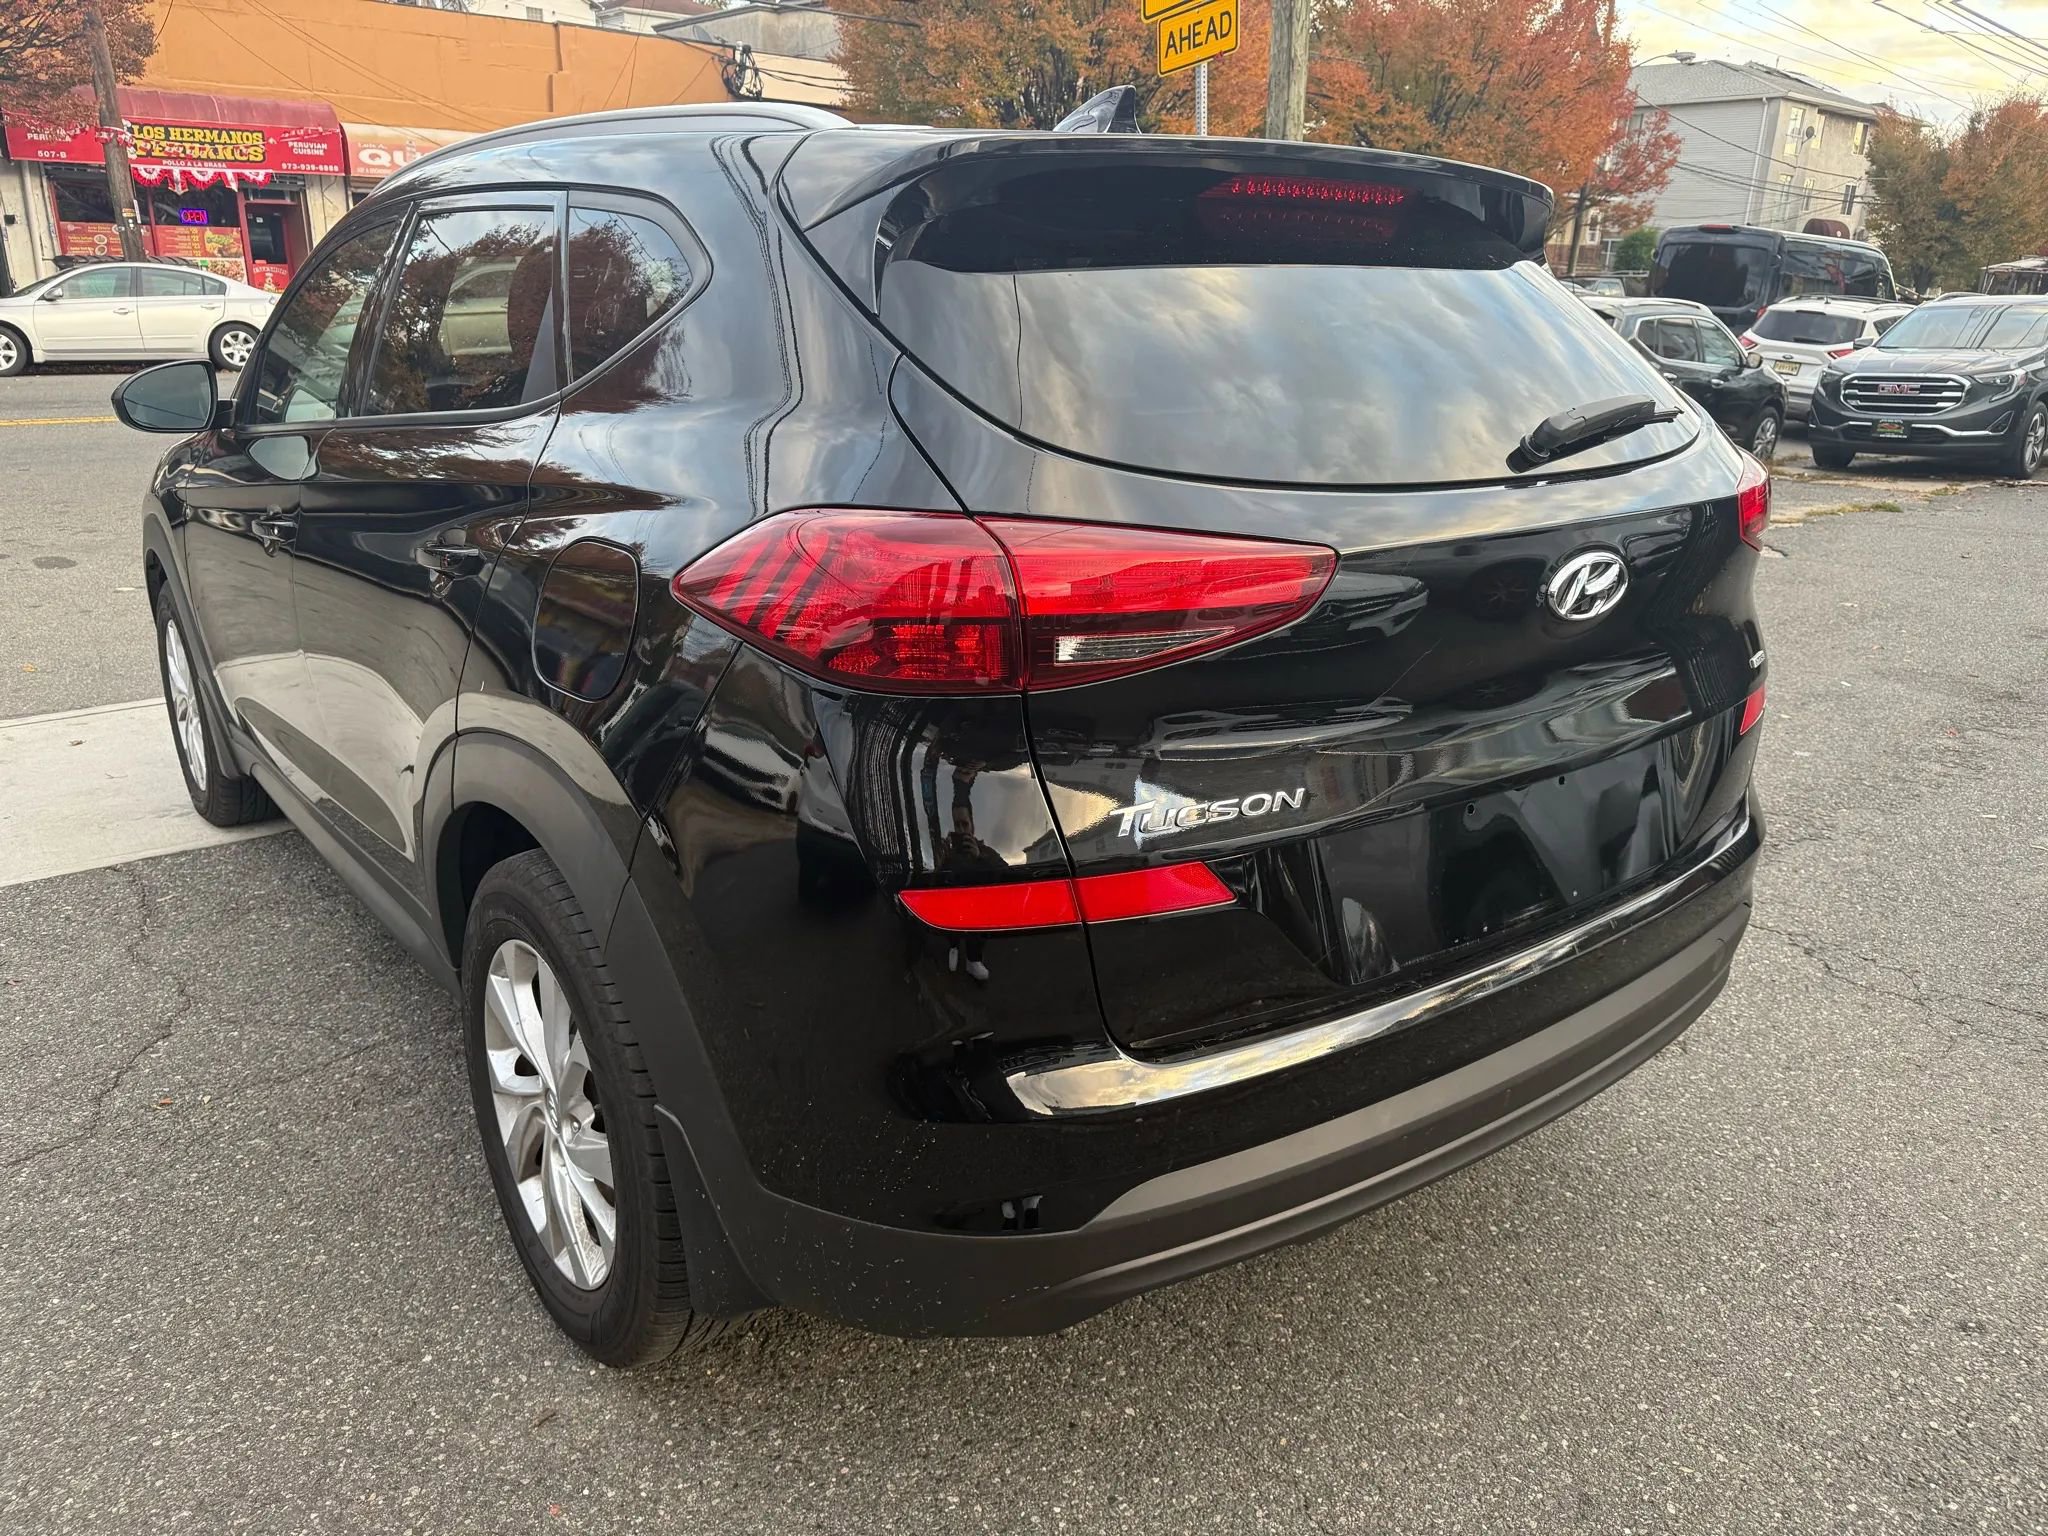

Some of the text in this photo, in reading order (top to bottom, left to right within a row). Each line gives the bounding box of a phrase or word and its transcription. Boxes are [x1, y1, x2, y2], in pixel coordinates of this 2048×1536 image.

[1164, 11, 1233, 59] AHEAD
[132, 124, 263, 145] LOS HERMANOS
[288, 141, 328, 150] PERUVIAN
[37, 150, 67, 159] 507-B
[293, 148, 325, 156] CUISINE
[162, 159, 186, 167] POLLO
[181, 209, 207, 223] OPEN
[1878, 384, 1921, 396] GMC
